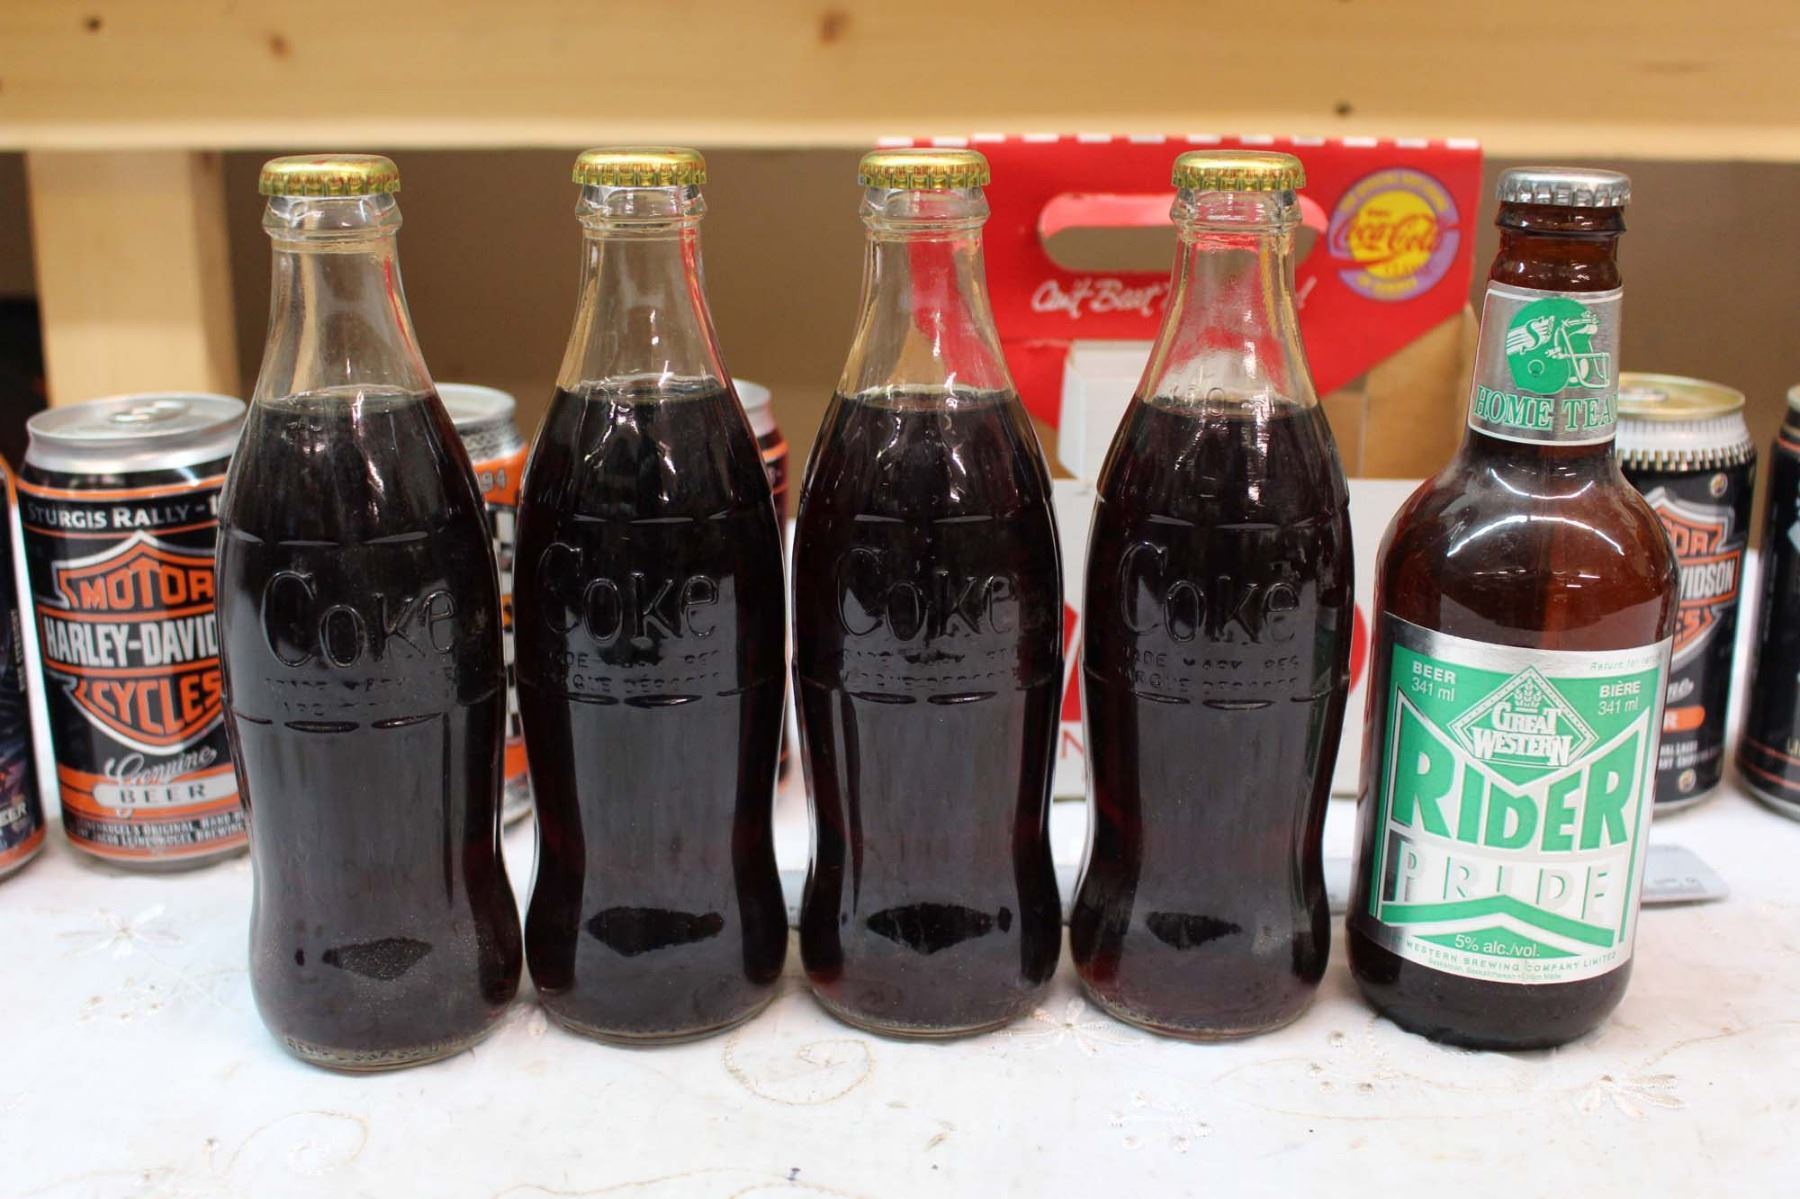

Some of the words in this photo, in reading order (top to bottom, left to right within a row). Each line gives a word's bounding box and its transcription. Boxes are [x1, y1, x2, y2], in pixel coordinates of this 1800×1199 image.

[1473, 384, 1553, 432] HOME
[28, 502, 108, 529] STURGIS
[112, 503, 190, 529] RALLY
[80, 559, 215, 611] MOTOR
[537, 542, 720, 649] Coke
[837, 547, 1019, 642] Coke
[1118, 540, 1299, 645] Coke
[260, 569, 456, 669] Coke
[1411, 676, 1435, 697] 341
[1438, 684, 1456, 702] ml
[1412, 660, 1456, 685] BEER
[1600, 680, 1641, 698] BIÈRE
[92, 669, 223, 736] CYCLES
[1491, 701, 1566, 734] GREAT
[1598, 699, 1621, 716] 341
[1624, 696, 1639, 712] ml
[1472, 727, 1573, 767] WESTERN
[104, 747, 217, 804] Genuine
[120, 783, 207, 804] BEER
[1391, 700, 1641, 853] RIDER
[1391, 840, 1615, 927] PRIDE
[1406, 940, 1458, 963] WESTERN
[1464, 956, 1521, 973] BREWING
[1526, 960, 1580, 973] COMPANY
[1455, 934, 1479, 952] 5%
[1483, 935, 1541, 957] alc./vol.
